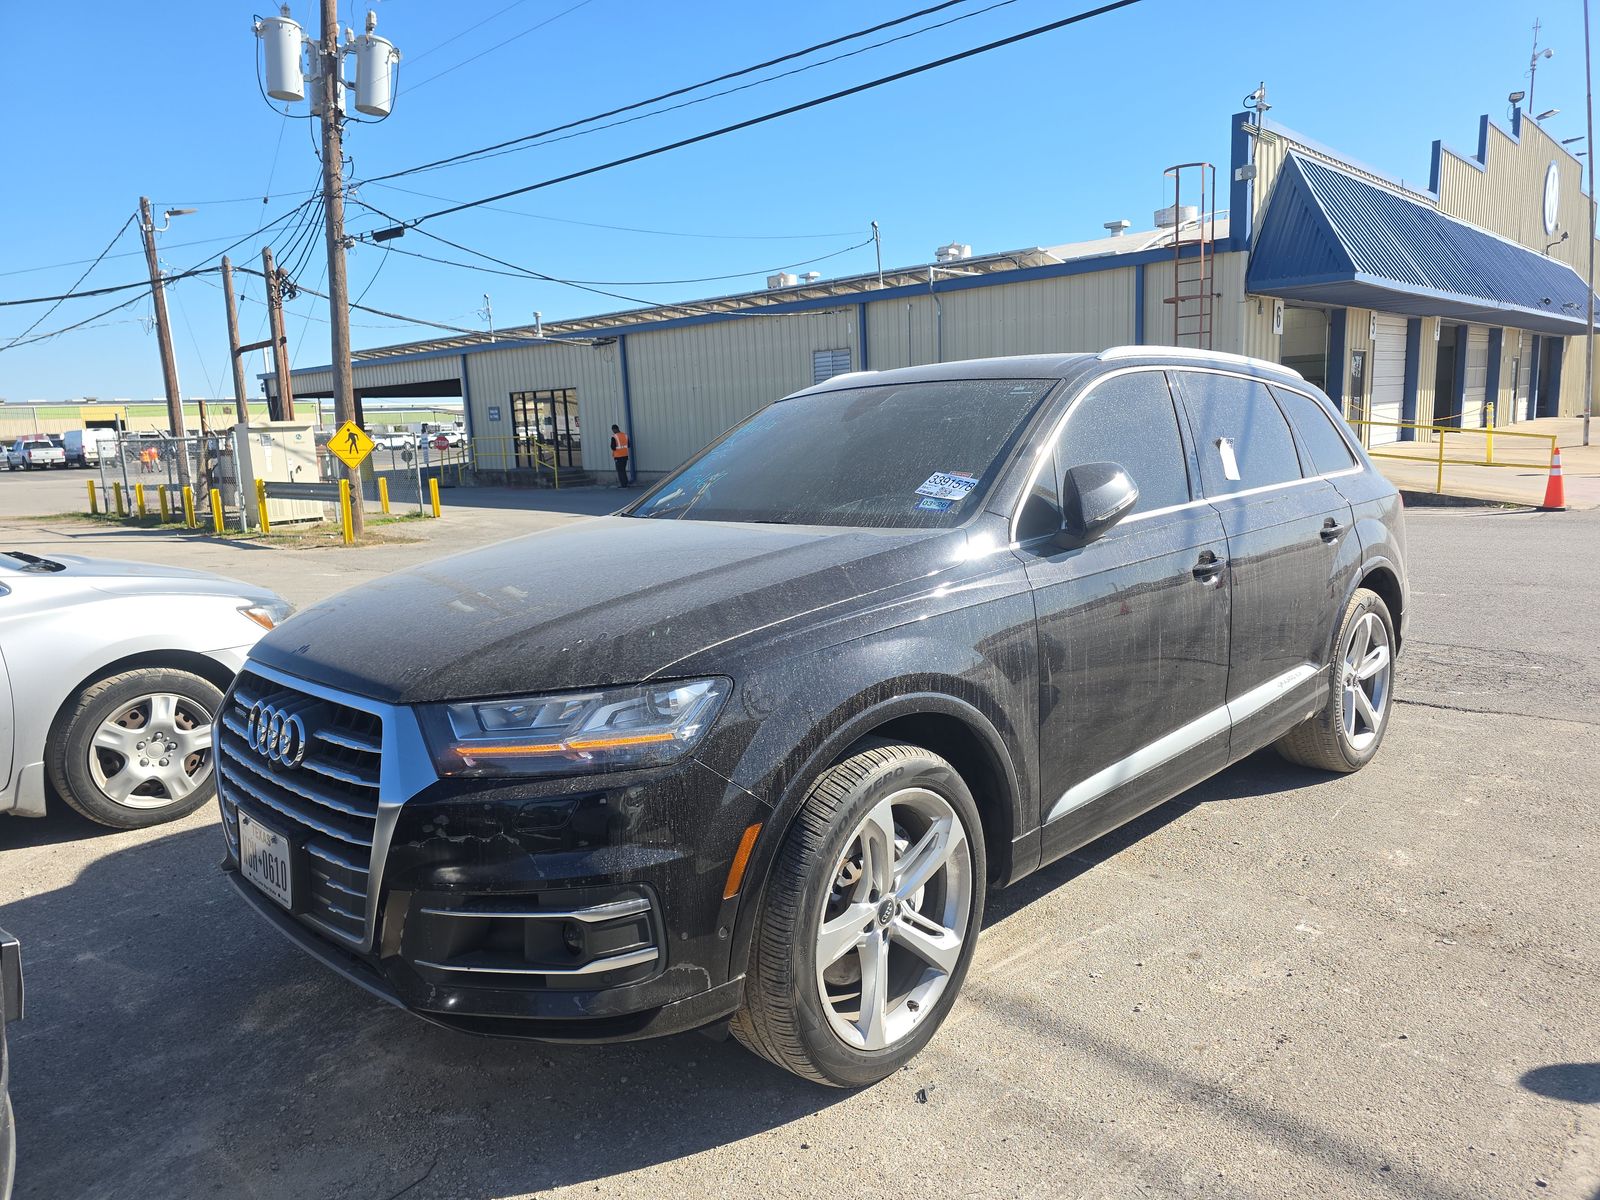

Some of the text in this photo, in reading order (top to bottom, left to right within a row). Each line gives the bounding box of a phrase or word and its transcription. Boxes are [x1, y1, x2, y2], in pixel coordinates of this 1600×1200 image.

[1276, 306, 1282, 328] 6
[1372, 316, 1376, 334] 5
[928, 474, 976, 492] 3391578
[252, 826, 272, 846] TEXAS
